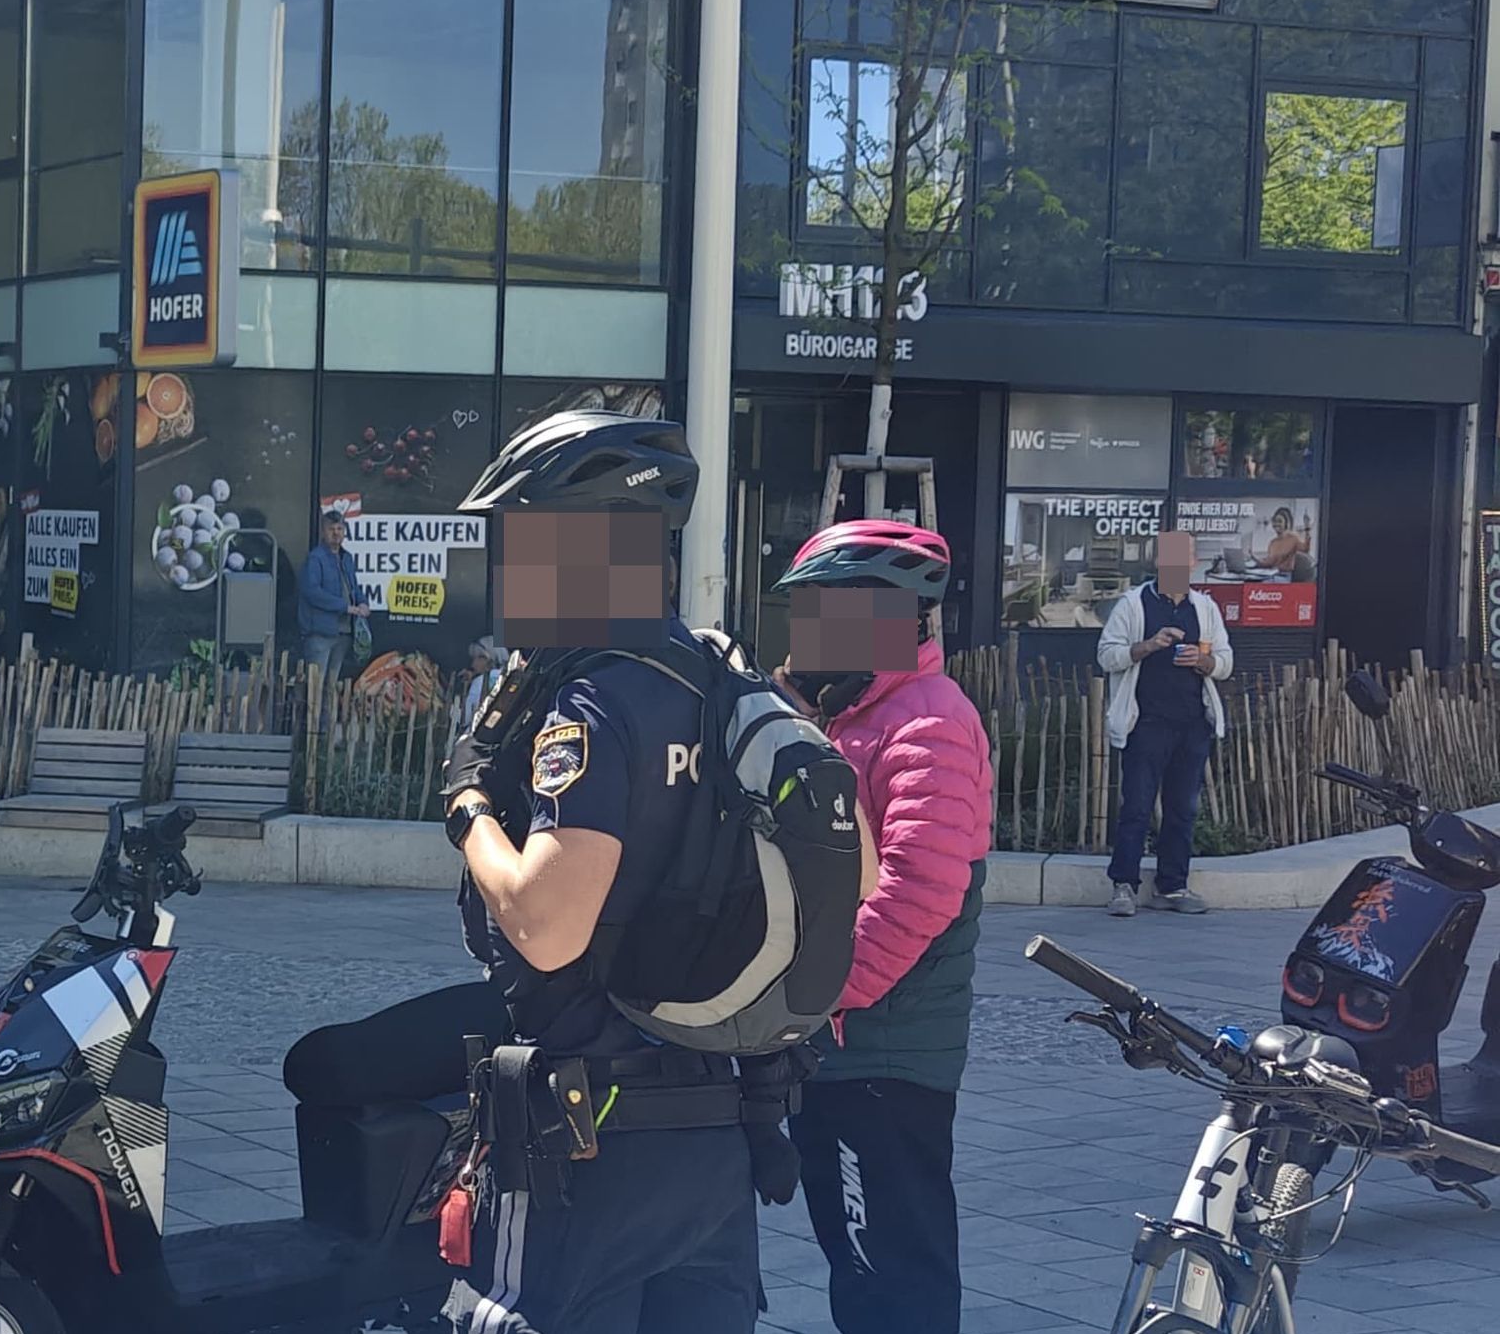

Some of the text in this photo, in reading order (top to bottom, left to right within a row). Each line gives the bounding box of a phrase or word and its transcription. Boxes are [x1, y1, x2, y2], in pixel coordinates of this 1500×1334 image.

[150, 293, 204, 322] HOFER
[1010, 429, 1045, 450] IWG
[626, 466, 661, 487] uvex
[1044, 498, 1164, 517] THE PERFECT
[28, 515, 96, 538] ALLE KAUFEN
[395, 522, 479, 542] KAUFEN
[1095, 518, 1160, 536] OFFICE
[1177, 518, 1194, 531] DEN
[1194, 519, 1206, 531] DU
[27, 546, 77, 569] ALLES EIN
[355, 553, 442, 573] LLES EIN
[27, 576, 49, 598] ZUM
[396, 580, 438, 596] HOFER
[97, 1127, 141, 1209] POWER
[837, 1137, 867, 1227] NIKE
